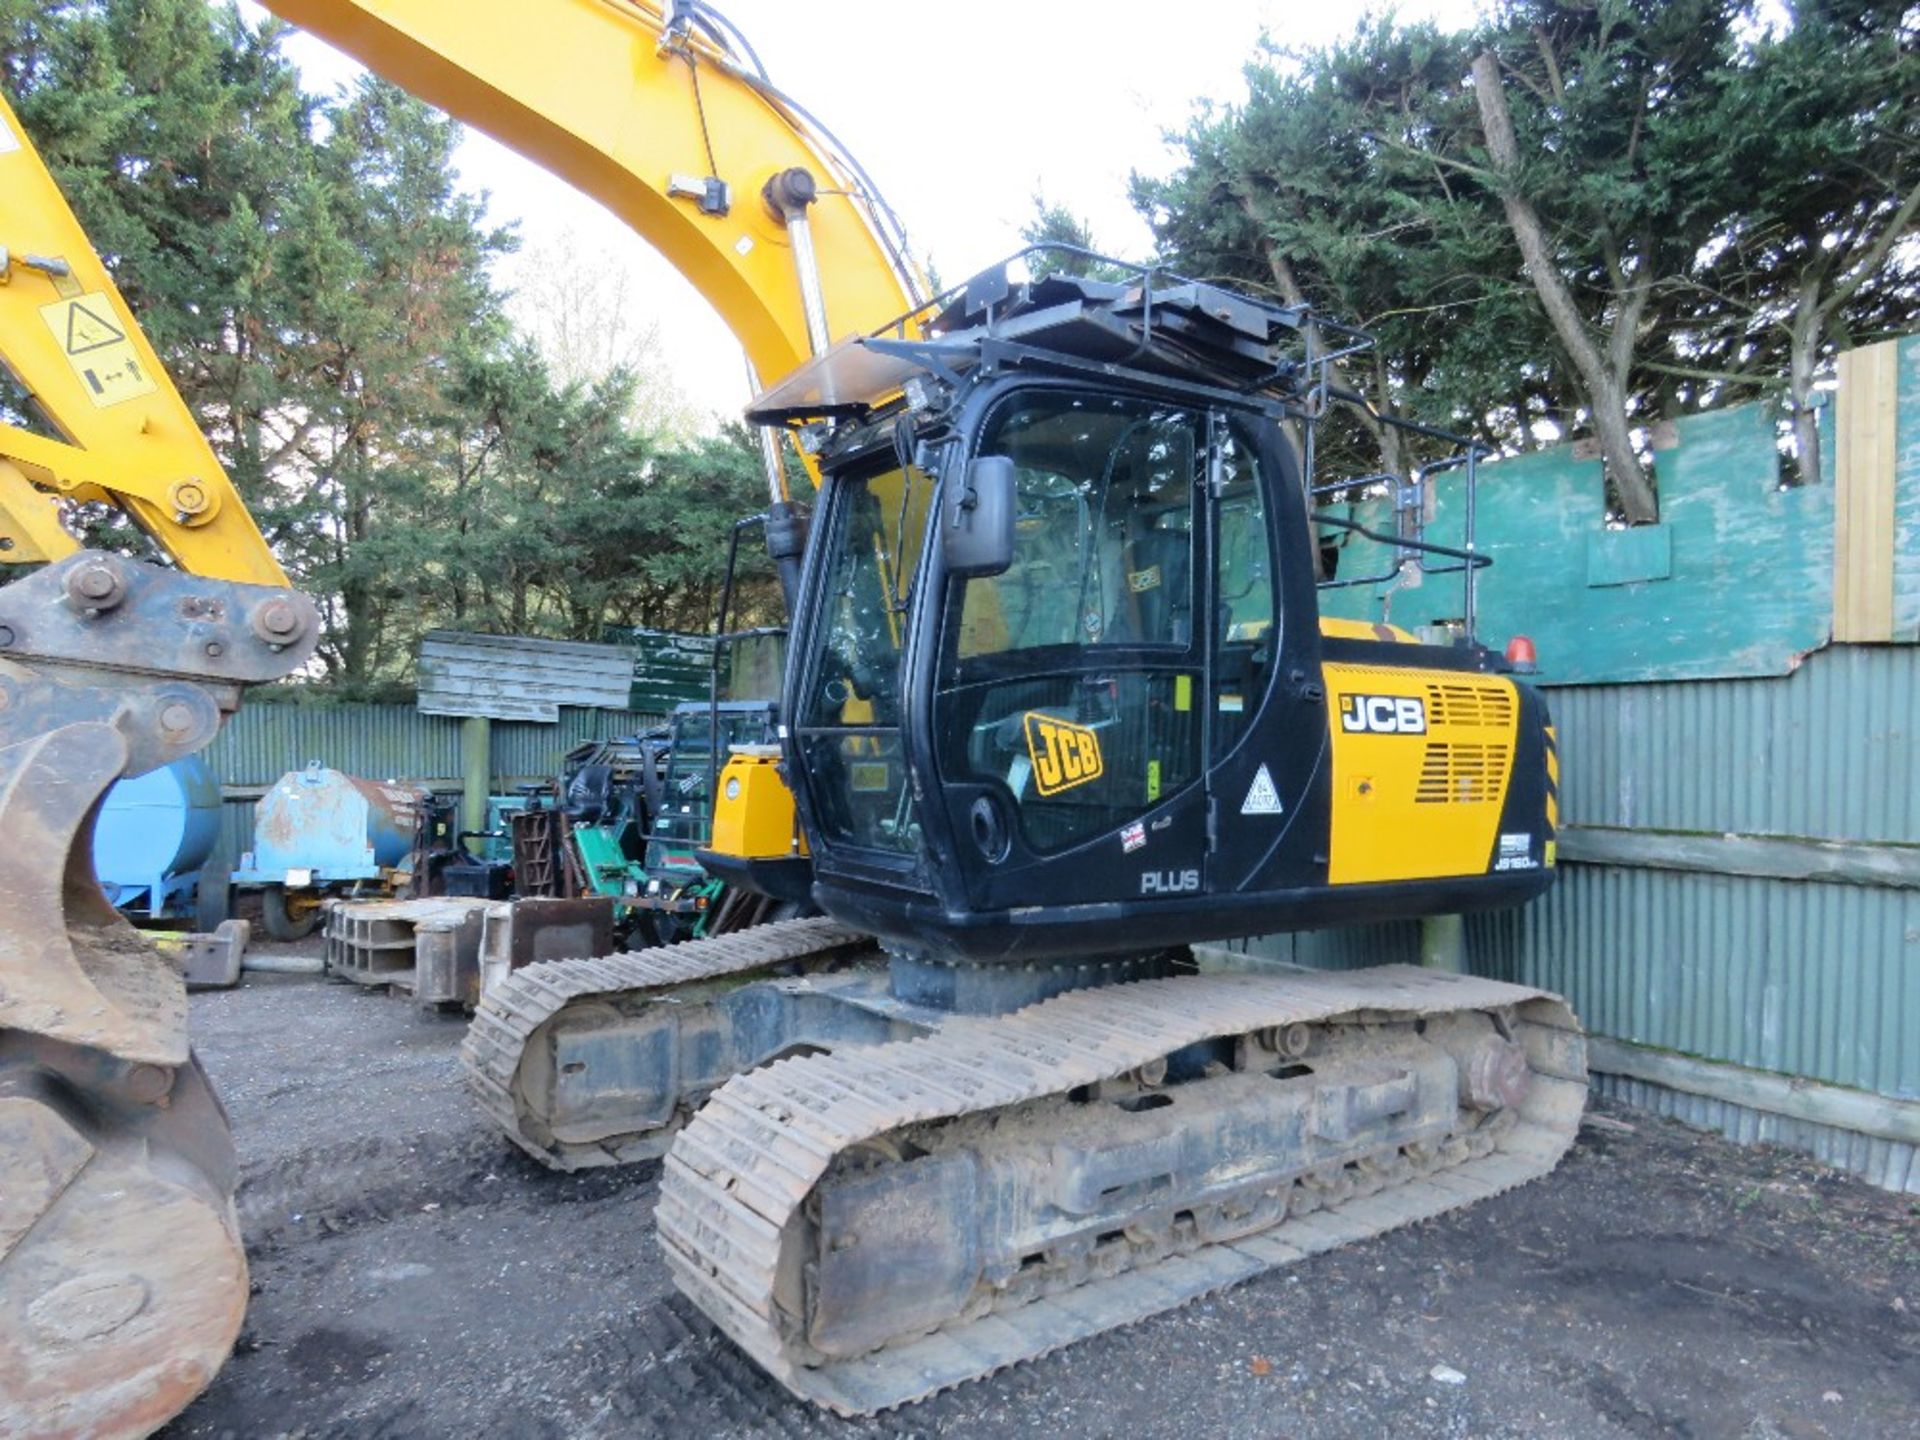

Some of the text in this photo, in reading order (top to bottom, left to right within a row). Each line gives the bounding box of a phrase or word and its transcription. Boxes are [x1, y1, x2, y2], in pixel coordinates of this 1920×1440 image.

[1342, 696, 1425, 733] JCB
[1038, 723, 1098, 786] JCB
[1141, 869, 1199, 894] PLUS
